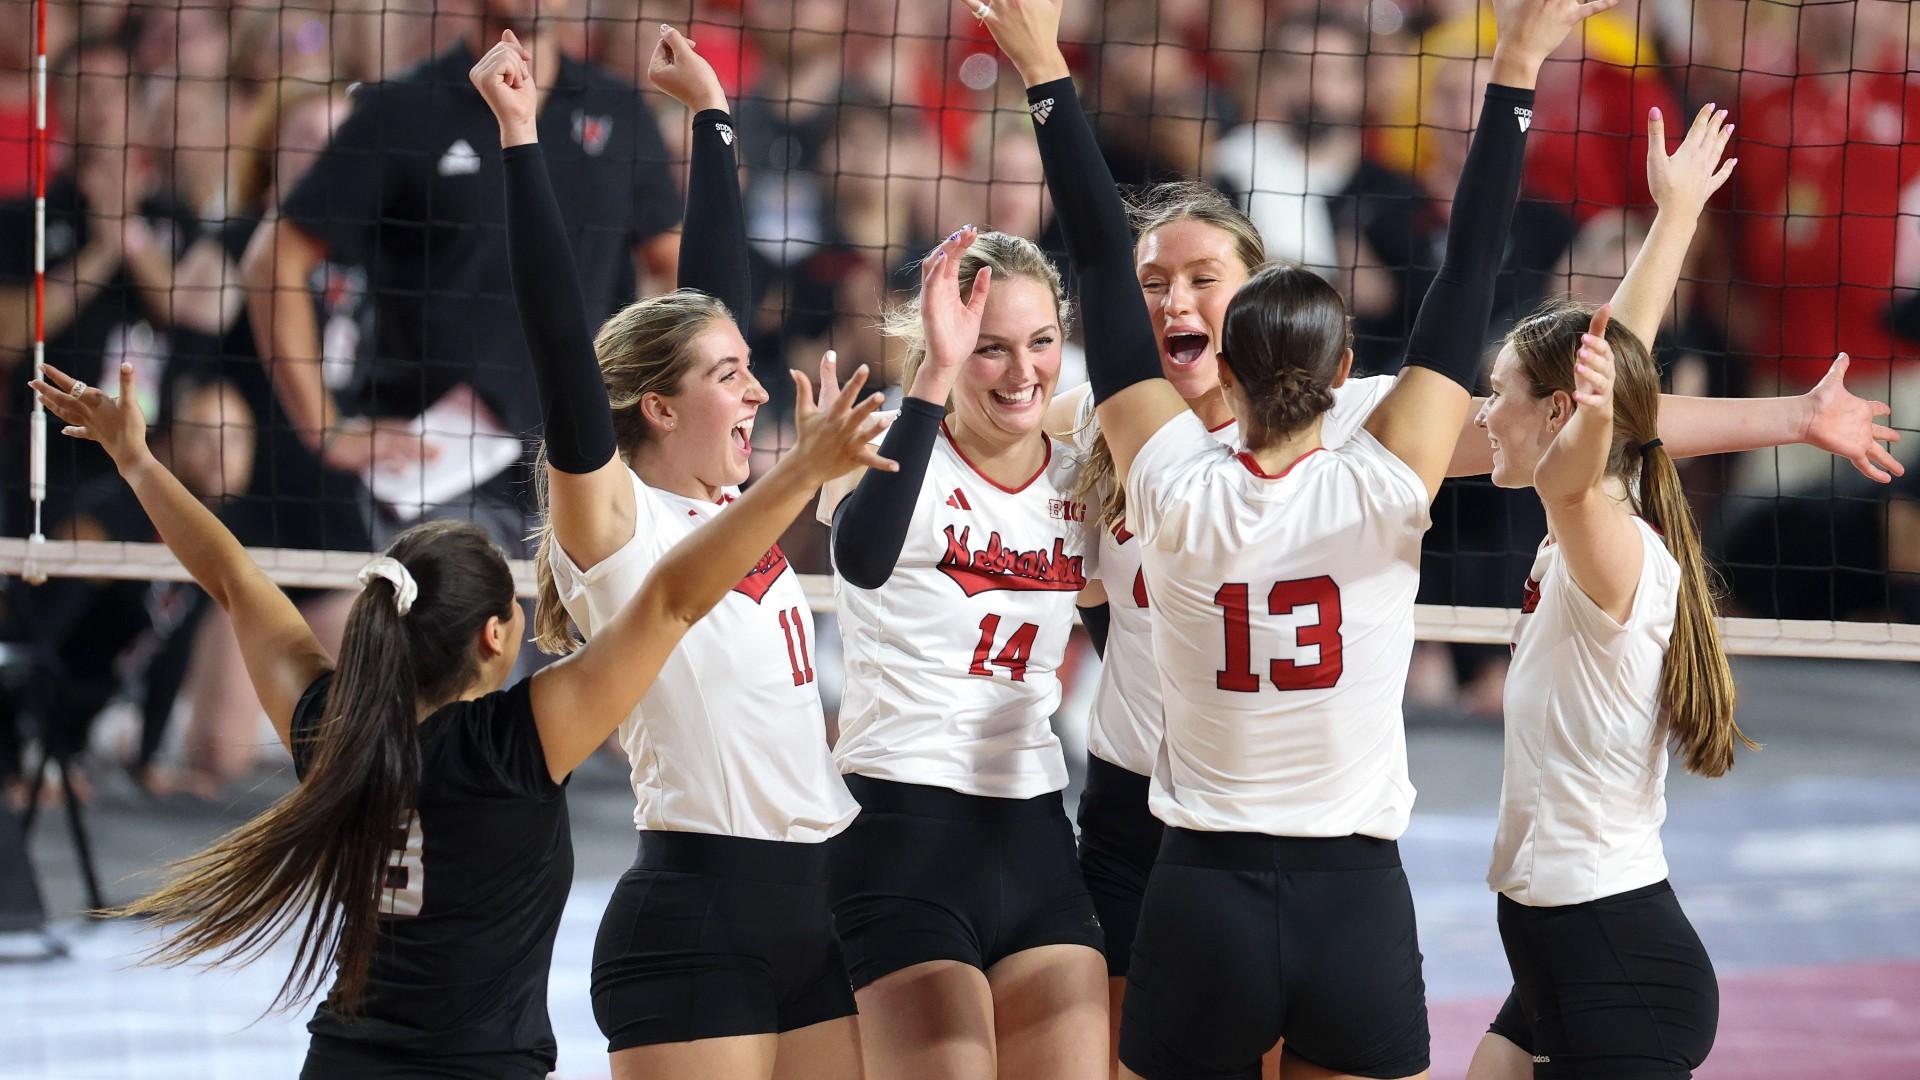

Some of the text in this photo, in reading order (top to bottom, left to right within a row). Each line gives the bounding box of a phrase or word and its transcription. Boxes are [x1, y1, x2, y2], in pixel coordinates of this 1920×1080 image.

[1029, 97, 1055, 114] adida
[936, 524, 1087, 584] Nebraska
[778, 606, 814, 687] 11
[968, 612, 1040, 683] 14
[1214, 574, 1344, 693] 13
